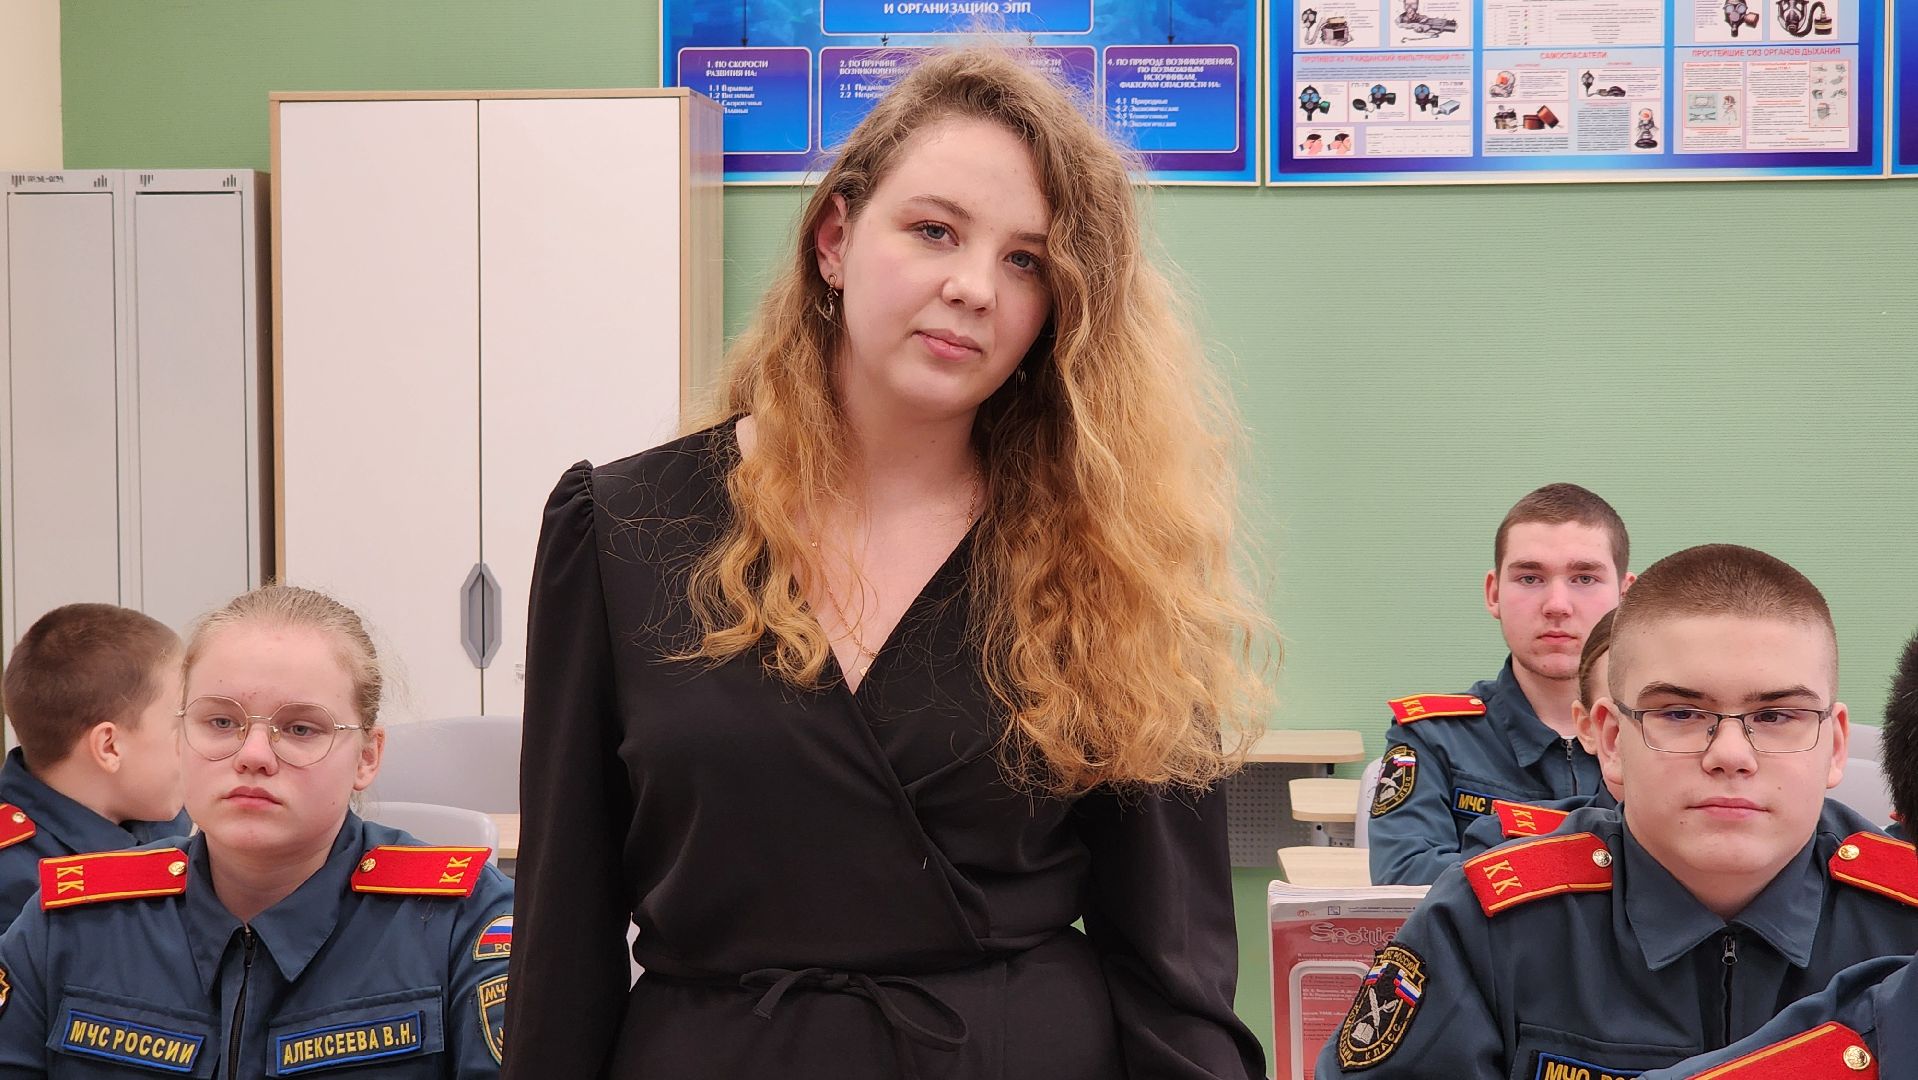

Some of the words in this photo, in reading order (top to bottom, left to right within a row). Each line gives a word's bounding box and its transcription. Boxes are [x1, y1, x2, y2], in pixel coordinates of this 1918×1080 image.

[884, 4, 894, 14] И
[897, 3, 999, 15] ОРГАНИЗАЦИЮ
[1002, 1, 1031, 13] ЭПП
[1540, 52, 1608, 60] САМОСПАСАТЕЛИ
[1692, 49, 1745, 57] ПРОСТЕЙШИЕ
[1802, 47, 1840, 55] ДЫХАНИЯ
[715, 60, 727, 68] ПО
[728, 60, 768, 68] СКОРОСТИ
[1458, 794, 1486, 813] МЧС
[1310, 921, 1402, 950] Spotlig
[485, 983, 508, 1002] МЧ
[69, 1020, 110, 1047] МЧС
[112, 1029, 196, 1064] РОССИИ
[283, 1028, 380, 1066] АЛЕКСЕЕВА
[382, 1022, 417, 1047] В.Н.
